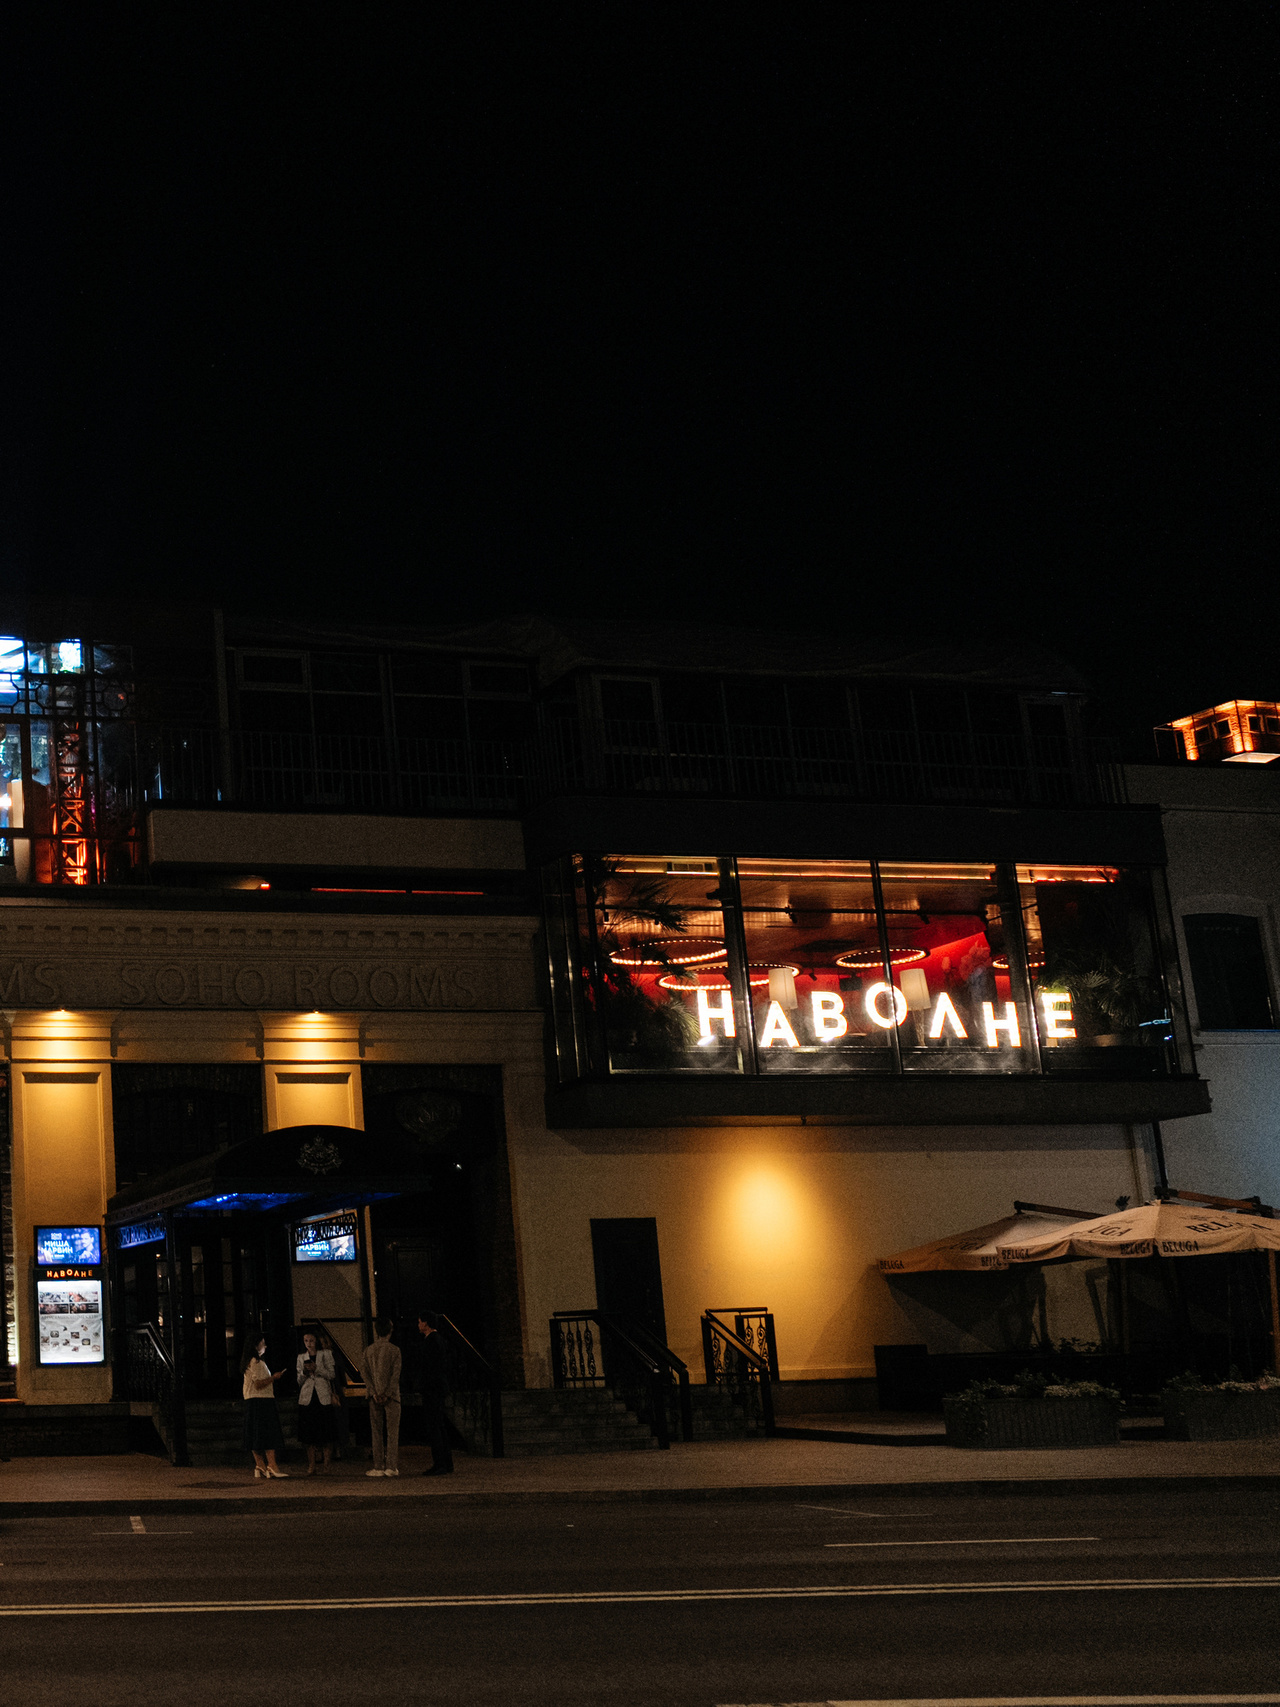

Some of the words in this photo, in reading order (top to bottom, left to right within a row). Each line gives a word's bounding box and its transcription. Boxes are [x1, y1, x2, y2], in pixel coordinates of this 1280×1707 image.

[121, 962, 270, 1006] SOHO
[295, 965, 477, 1008] ROOMS
[1162, 1240, 1199, 1253] BELUGA
[1001, 1248, 1031, 1259] BELUGA
[879, 1259, 905, 1270] BELUGA
[980, 1256, 1007, 1267] BELUG
